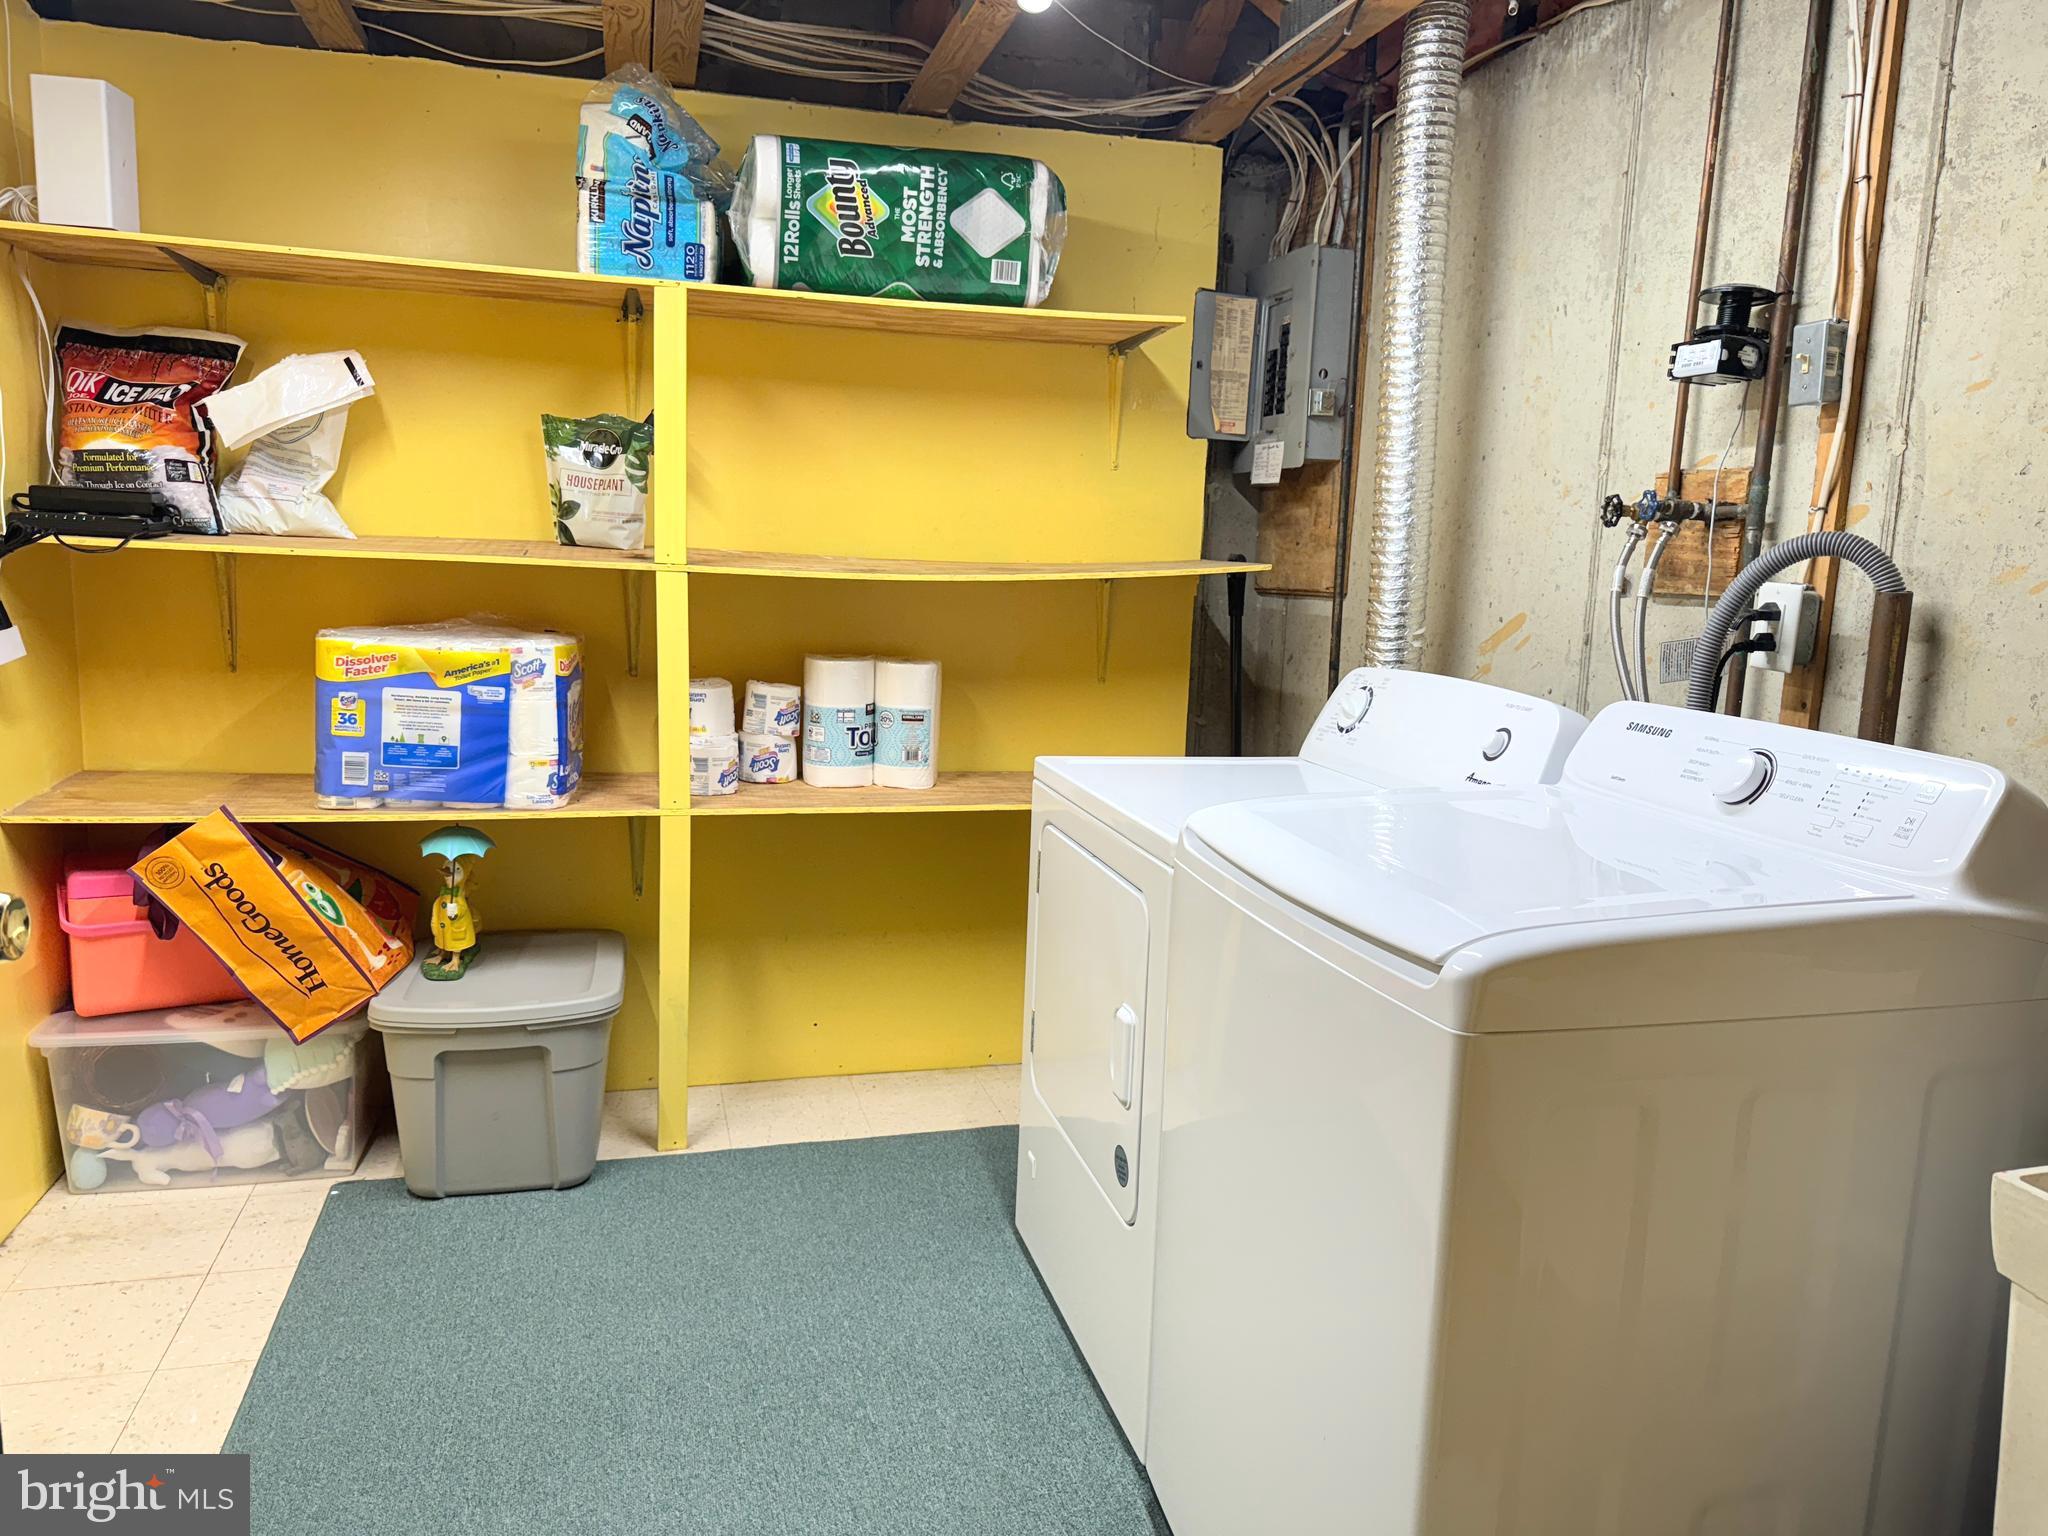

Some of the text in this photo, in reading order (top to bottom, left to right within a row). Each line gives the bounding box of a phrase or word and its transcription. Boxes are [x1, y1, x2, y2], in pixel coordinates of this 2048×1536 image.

[785, 168, 794, 198] Longer
[793, 169, 802, 200] Sheets
[826, 157, 874, 258] Bounty
[857, 179, 878, 239] Advanced
[901, 186, 918, 243] MOST
[915, 165, 935, 268] STRENGTH
[933, 168, 948, 269] & ABSORBENCY
[686, 246, 695, 275] 1120
[104, 383, 141, 403] ICE
[82, 452, 138, 462] Formulated for
[72, 462, 106, 472] Premium
[85, 480, 113, 489] Through
[114, 480, 126, 488] Ice
[135, 480, 163, 488] Contact
[566, 474, 624, 491] HOUSEPLANT
[335, 653, 397, 667] Dissolves
[444, 660, 491, 679] America's
[514, 658, 540, 677] Scott
[344, 664, 388, 677] Faster
[337, 712, 358, 725] 36
[1626, 721, 1673, 738] SAMSUNG
[751, 757, 777, 773] Scott
[204, 863, 327, 994] HomeGoods
